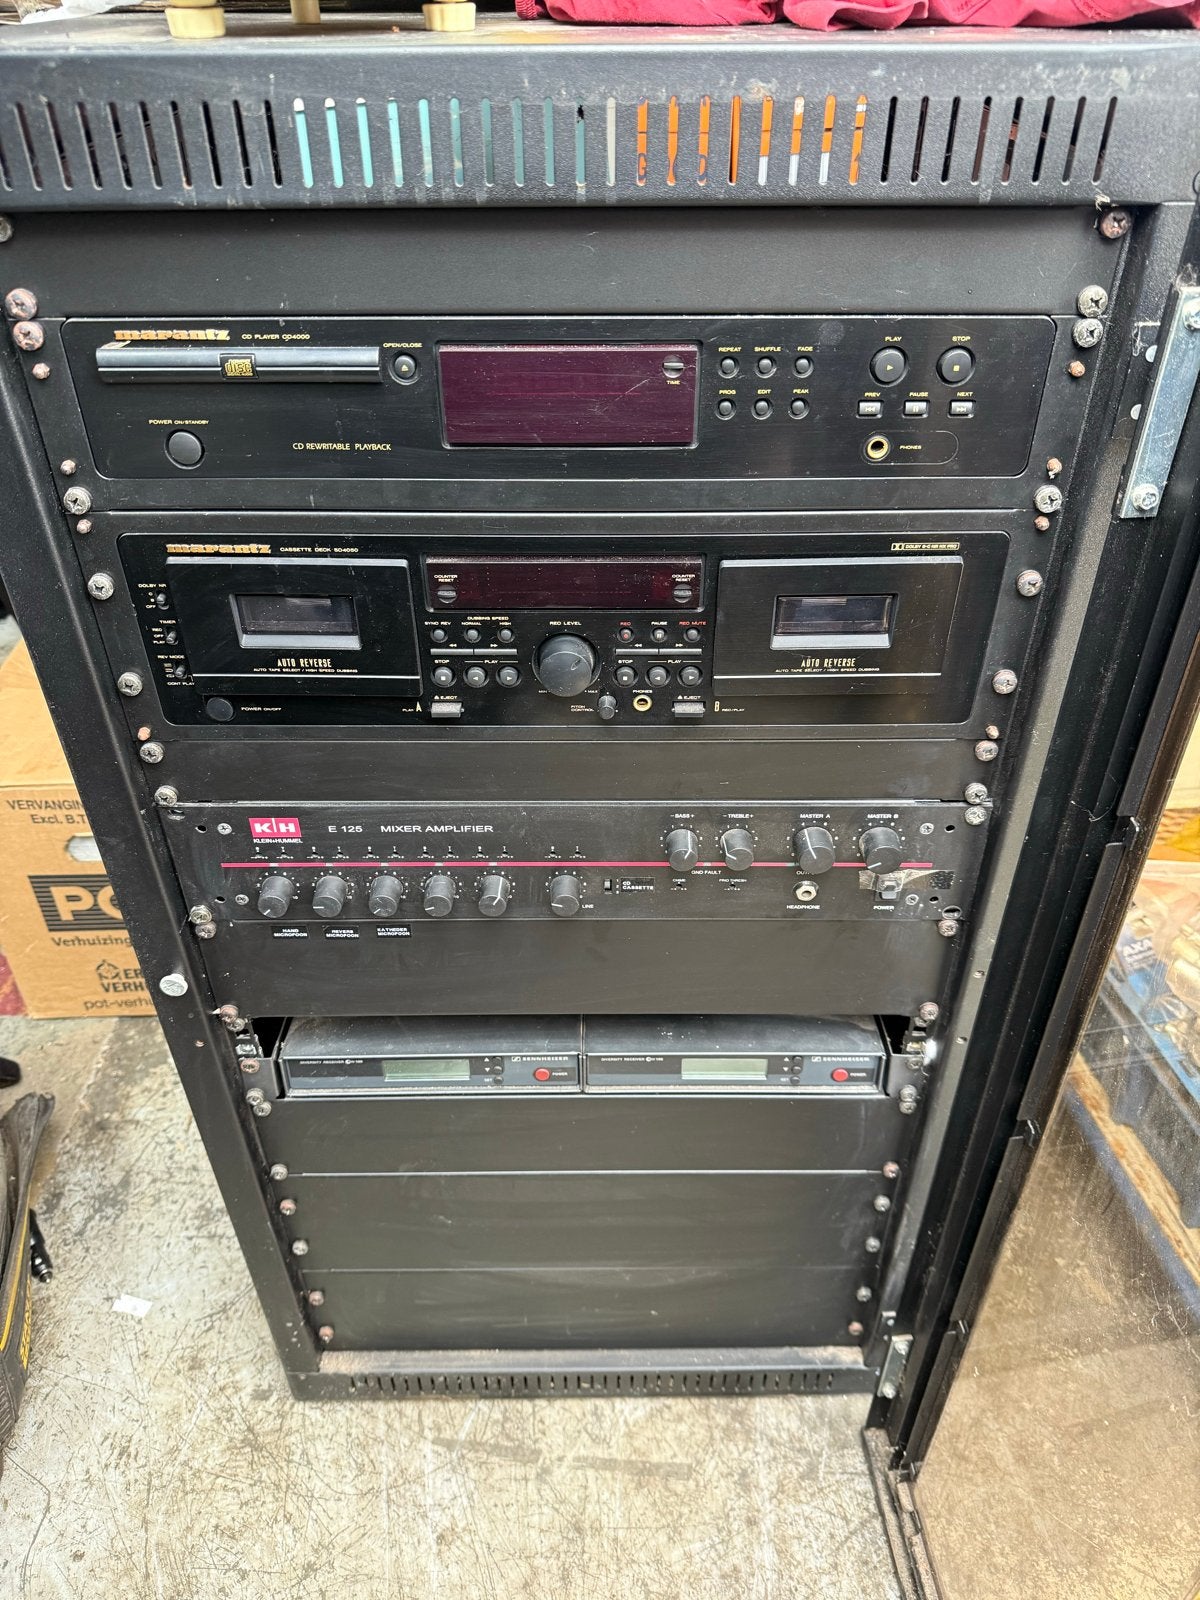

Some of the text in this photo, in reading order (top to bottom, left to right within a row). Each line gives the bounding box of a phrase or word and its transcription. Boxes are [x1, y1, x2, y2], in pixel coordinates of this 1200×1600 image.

[114, 329, 231, 341] marantz
[306, 442, 350, 450] REWRITABLE
[166, 544, 272, 554] marantz
[277, 658, 332, 668] AUTO REVERSE
[801, 658, 856, 668] AUTO REVERSE
[416, 701, 422, 712] A
[714, 701, 720, 712] B
[30, 814, 63, 824] Excl.
